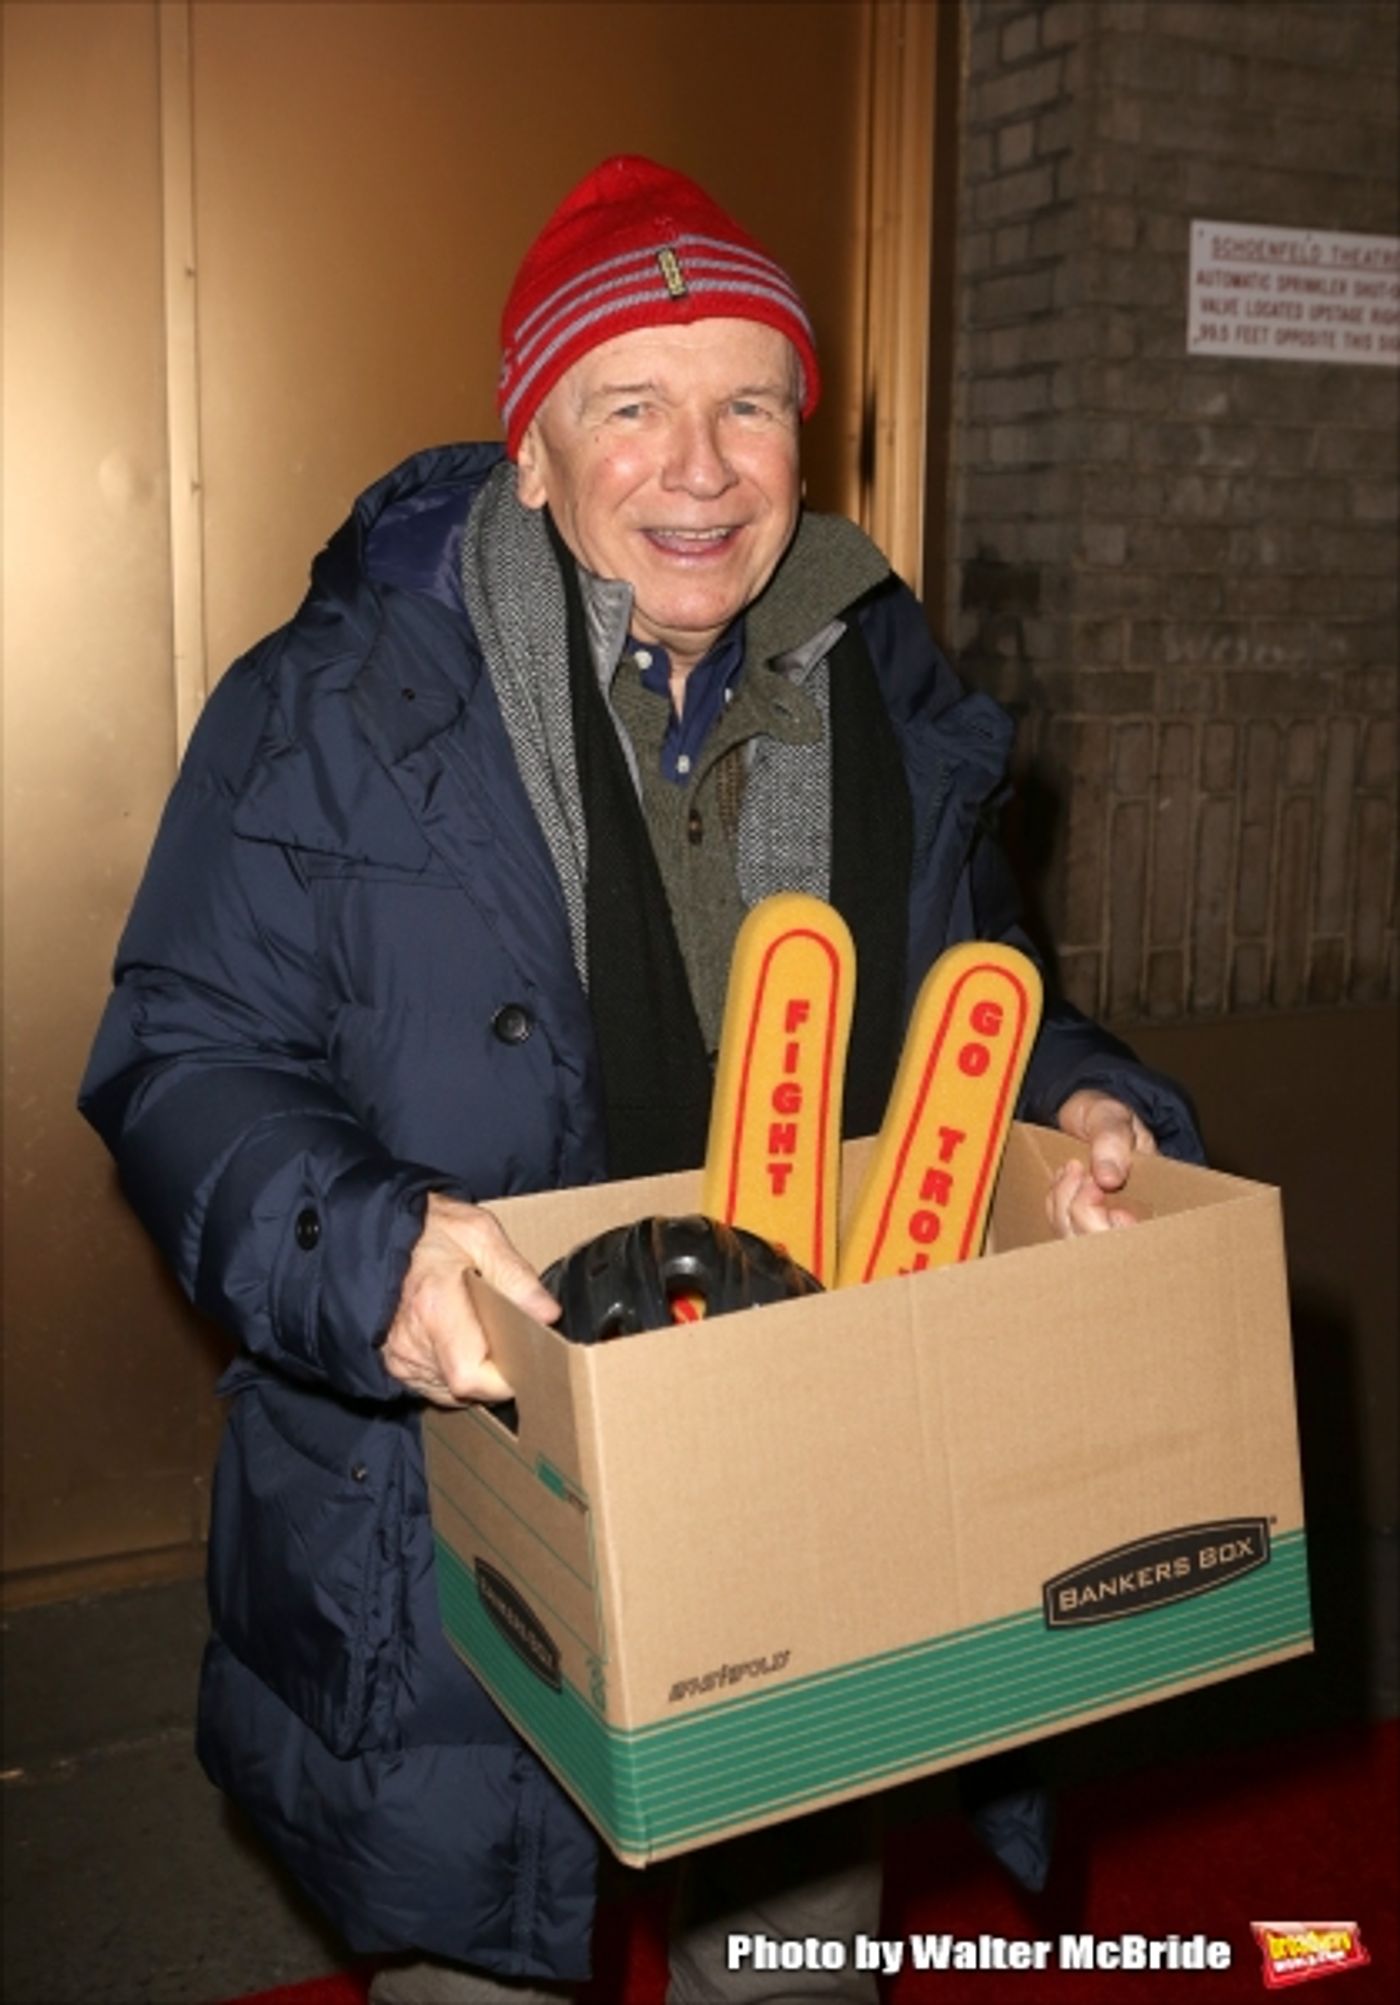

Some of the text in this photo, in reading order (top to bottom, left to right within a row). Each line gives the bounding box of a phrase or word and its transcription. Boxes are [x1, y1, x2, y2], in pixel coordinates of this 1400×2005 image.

[1197, 269, 1271, 291] AUTOMATIC
[1277, 274, 1347, 296] SPRINKLER
[1201, 299, 1238, 316] VALVE
[1246, 301, 1303, 320] LOCATED
[1310, 304, 1363, 322] UPSTAGE
[1236, 325, 1268, 345] FEET
[1275, 328, 1335, 350] OPPOSITE
[1344, 331, 1371, 351] THIS
[958, 1001, 1004, 1078] GO
[767, 1000, 810, 1196] FIGHT
[1058, 1537, 1254, 1612] BANKERS BOX
